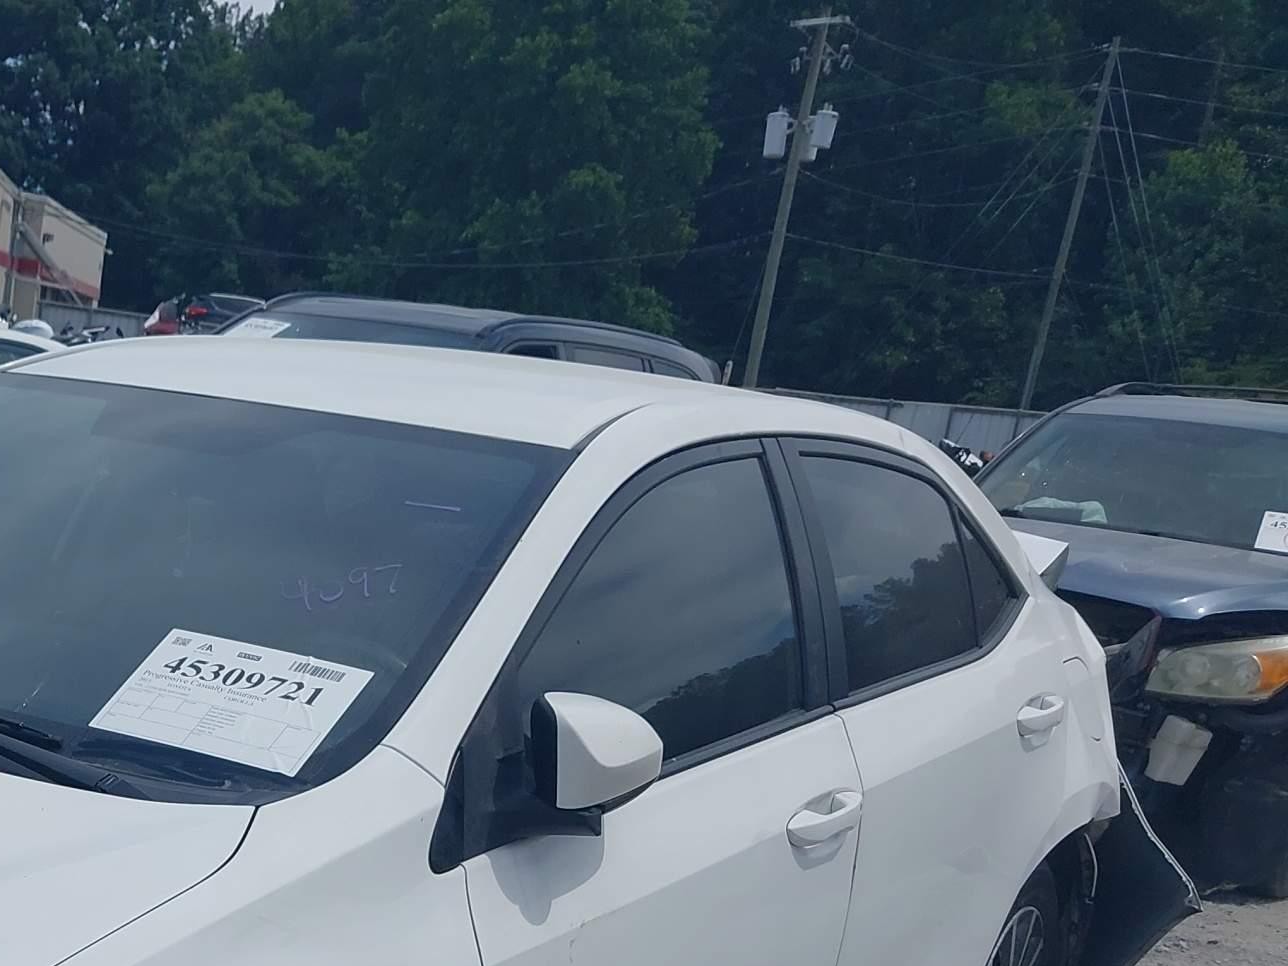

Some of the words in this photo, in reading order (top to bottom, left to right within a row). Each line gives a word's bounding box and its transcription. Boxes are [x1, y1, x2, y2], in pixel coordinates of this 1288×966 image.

[1270, 520, 1288, 529] 45
[143, 669, 188, 684] Progressive
[190, 679, 225, 693] Casualty
[227, 687, 267, 702] Insurance
[163, 656, 324, 706] 45309721
